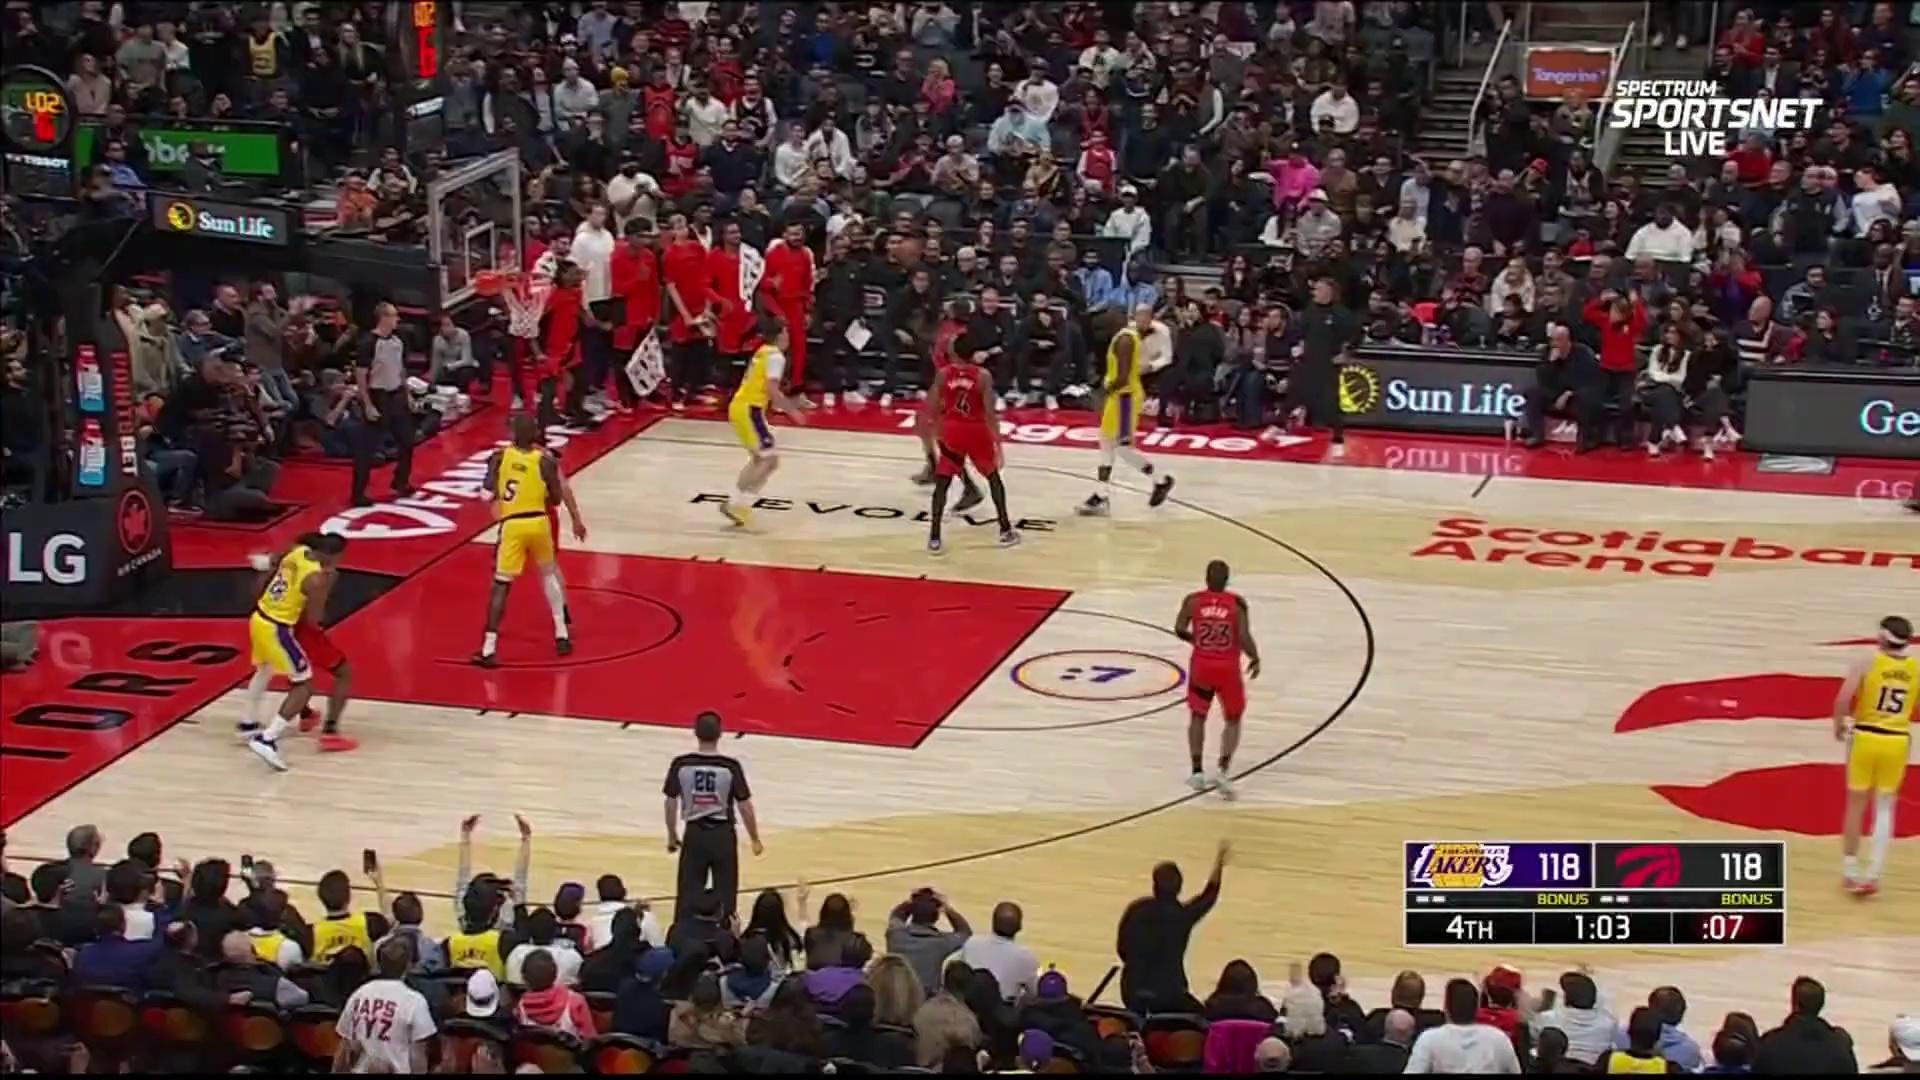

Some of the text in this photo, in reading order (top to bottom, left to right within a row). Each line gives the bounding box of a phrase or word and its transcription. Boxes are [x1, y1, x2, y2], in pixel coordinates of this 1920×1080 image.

[1533, 68, 1599, 85] Tangerine
[198, 211, 274, 238] Sun Life
[1386, 379, 1526, 416] Sun Life
[895, 409, 1258, 451] Tgeine
[1860, 400, 1920, 435] Ge
[503, 479, 520, 502] 5
[8, 532, 86, 584] LG
[1410, 540, 1714, 577] Arena
[1199, 621, 1232, 649] 23
[1876, 685, 1908, 714] 15
[694, 770, 716, 792] 26
